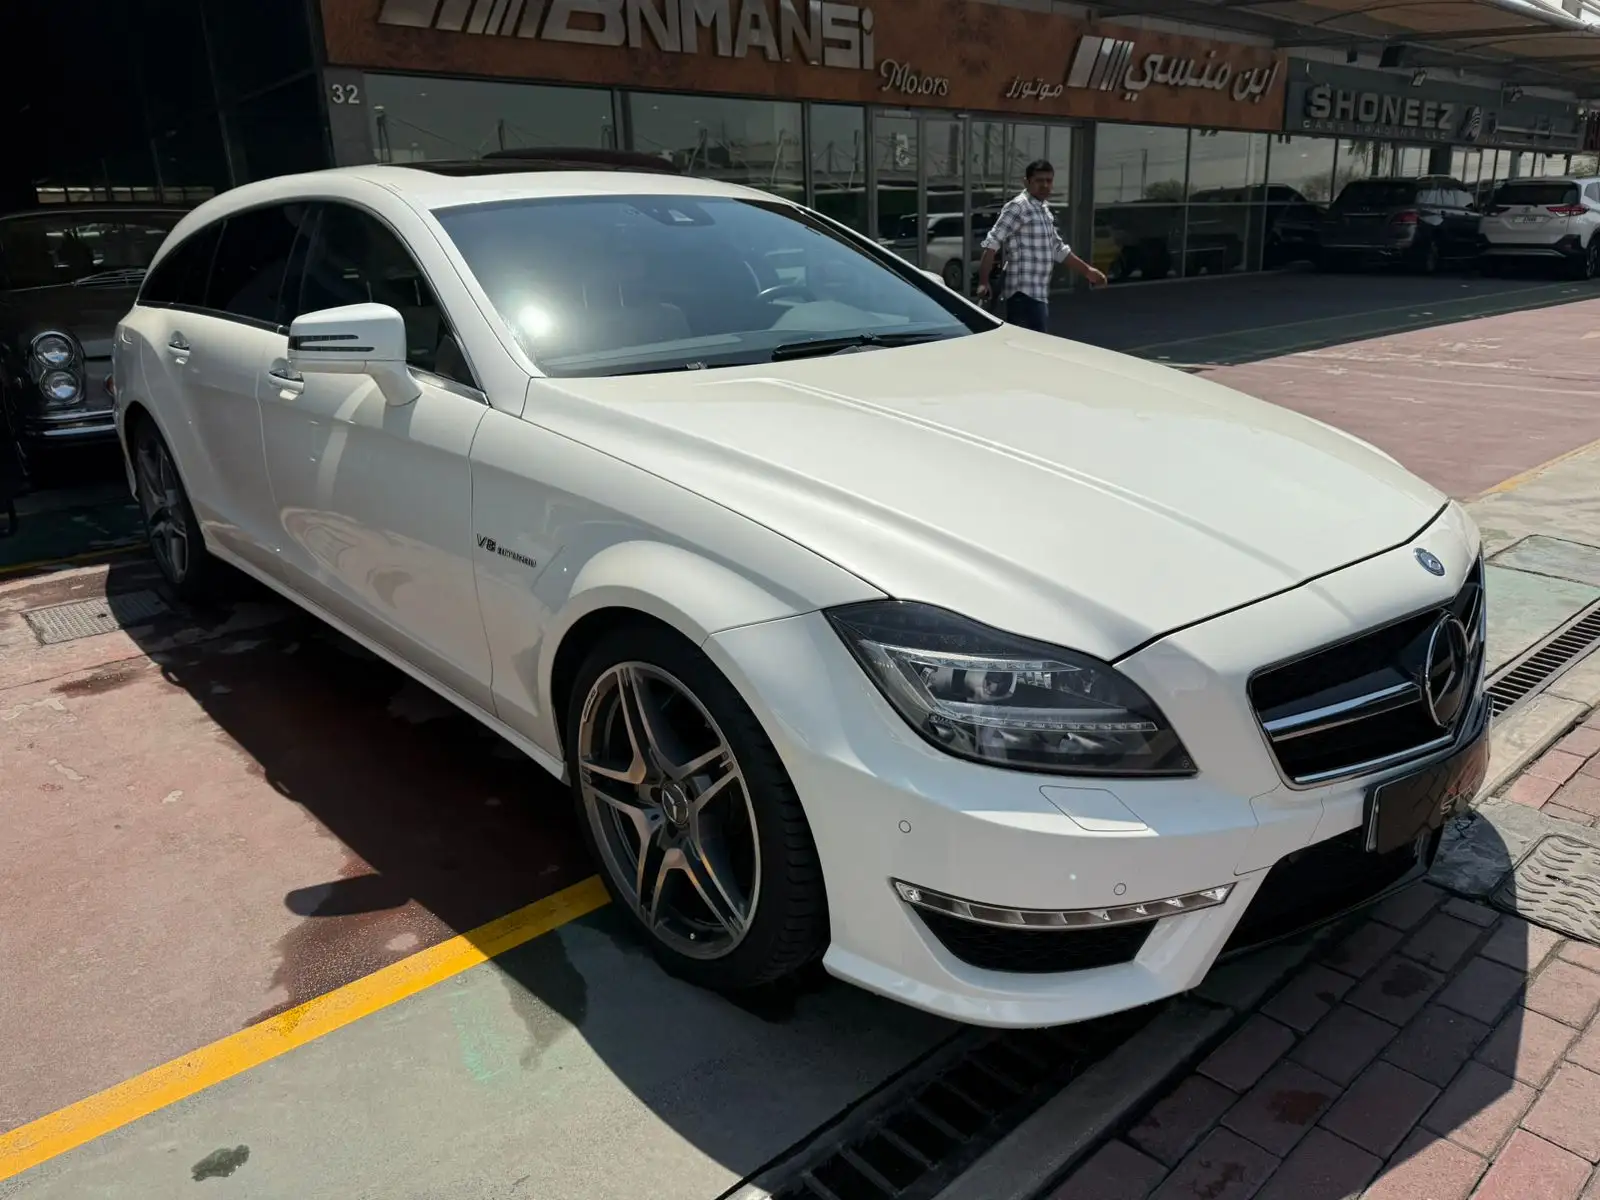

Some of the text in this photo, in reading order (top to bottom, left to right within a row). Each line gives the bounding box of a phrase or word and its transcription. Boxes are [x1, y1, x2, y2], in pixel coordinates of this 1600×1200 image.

[1006, 75, 1063, 99] موتورز
[1123, 50, 1281, 103] ابن منسي
[331, 84, 360, 105] 32
[1309, 86, 1455, 130] SHONEEZ
